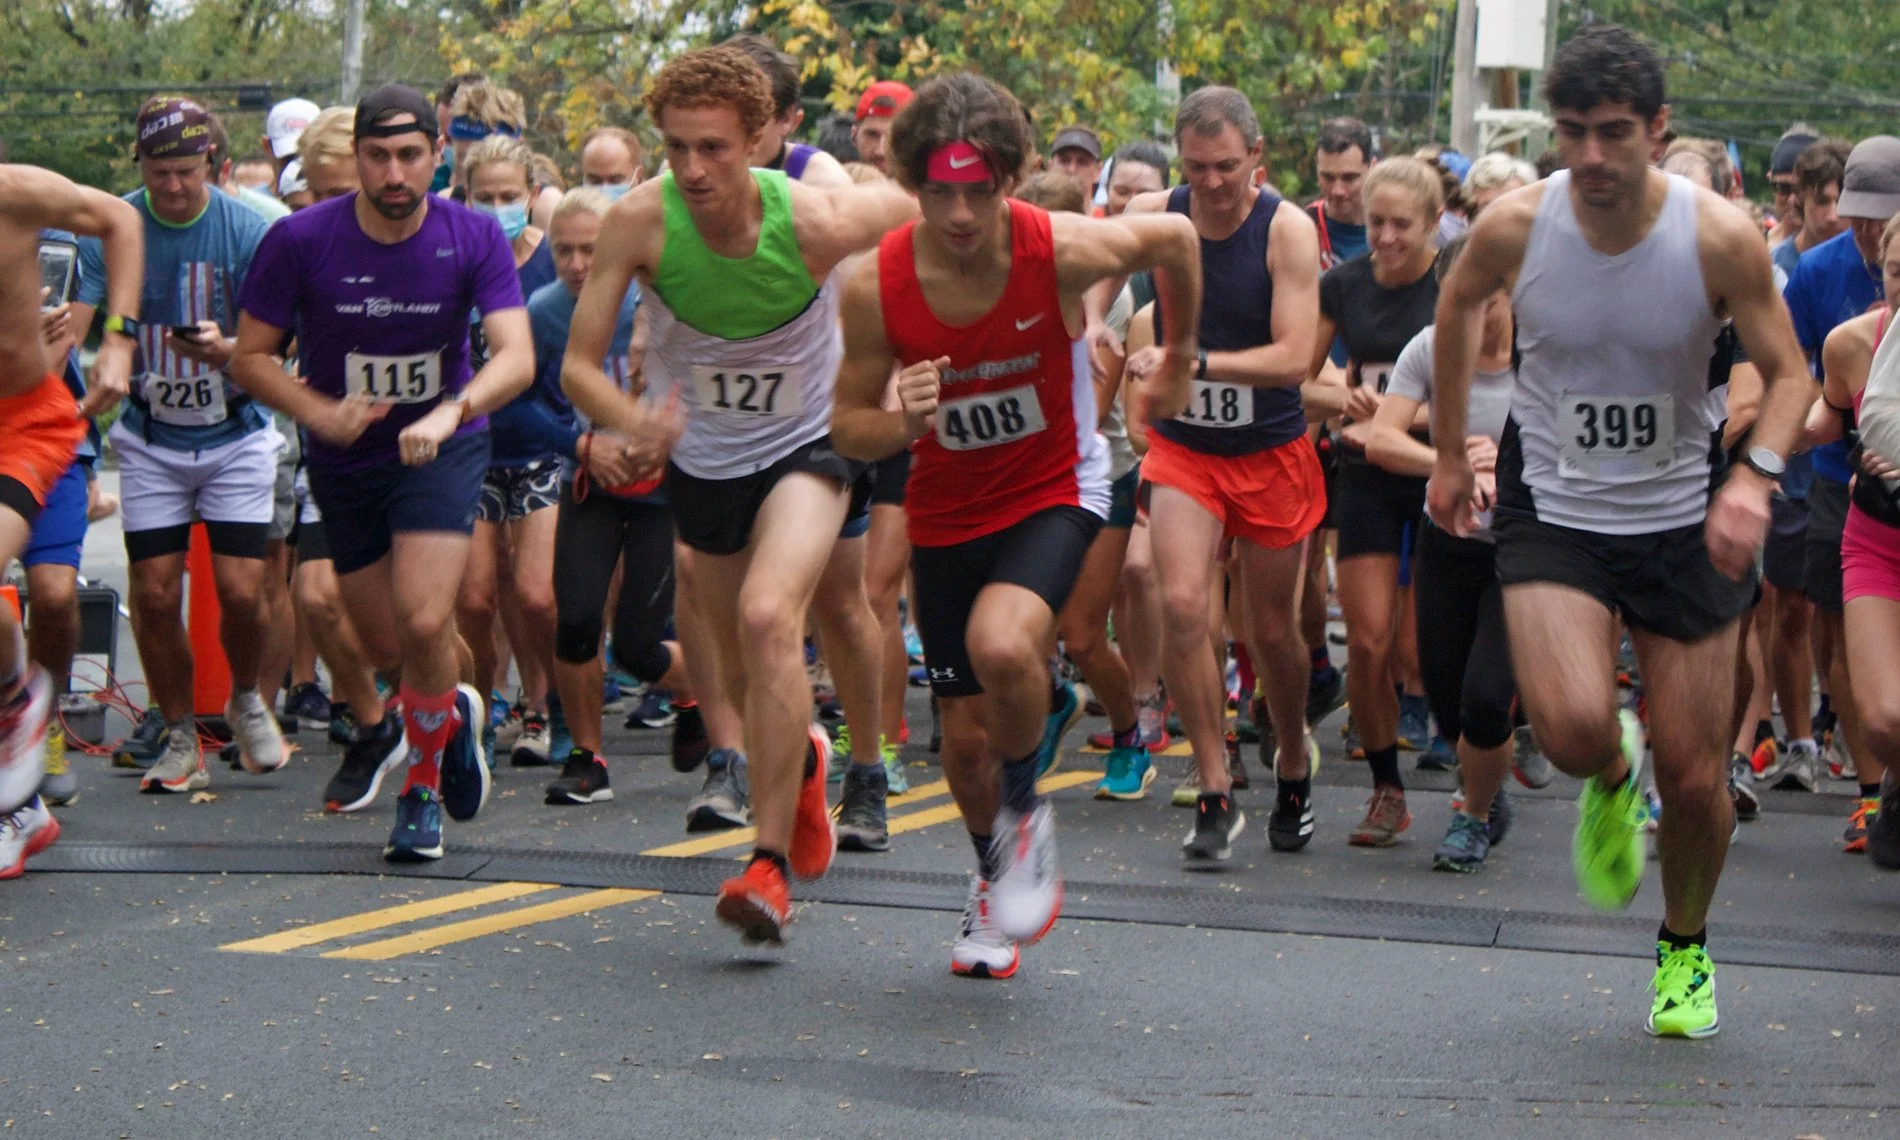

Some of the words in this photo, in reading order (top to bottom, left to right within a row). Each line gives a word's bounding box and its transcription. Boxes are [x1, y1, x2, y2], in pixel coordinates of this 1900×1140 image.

[156, 379, 212, 408] 226
[361, 360, 427, 397] 115
[711, 372, 784, 412] 127
[945, 397, 1025, 443] 408
[1574, 403, 1657, 449] 399
